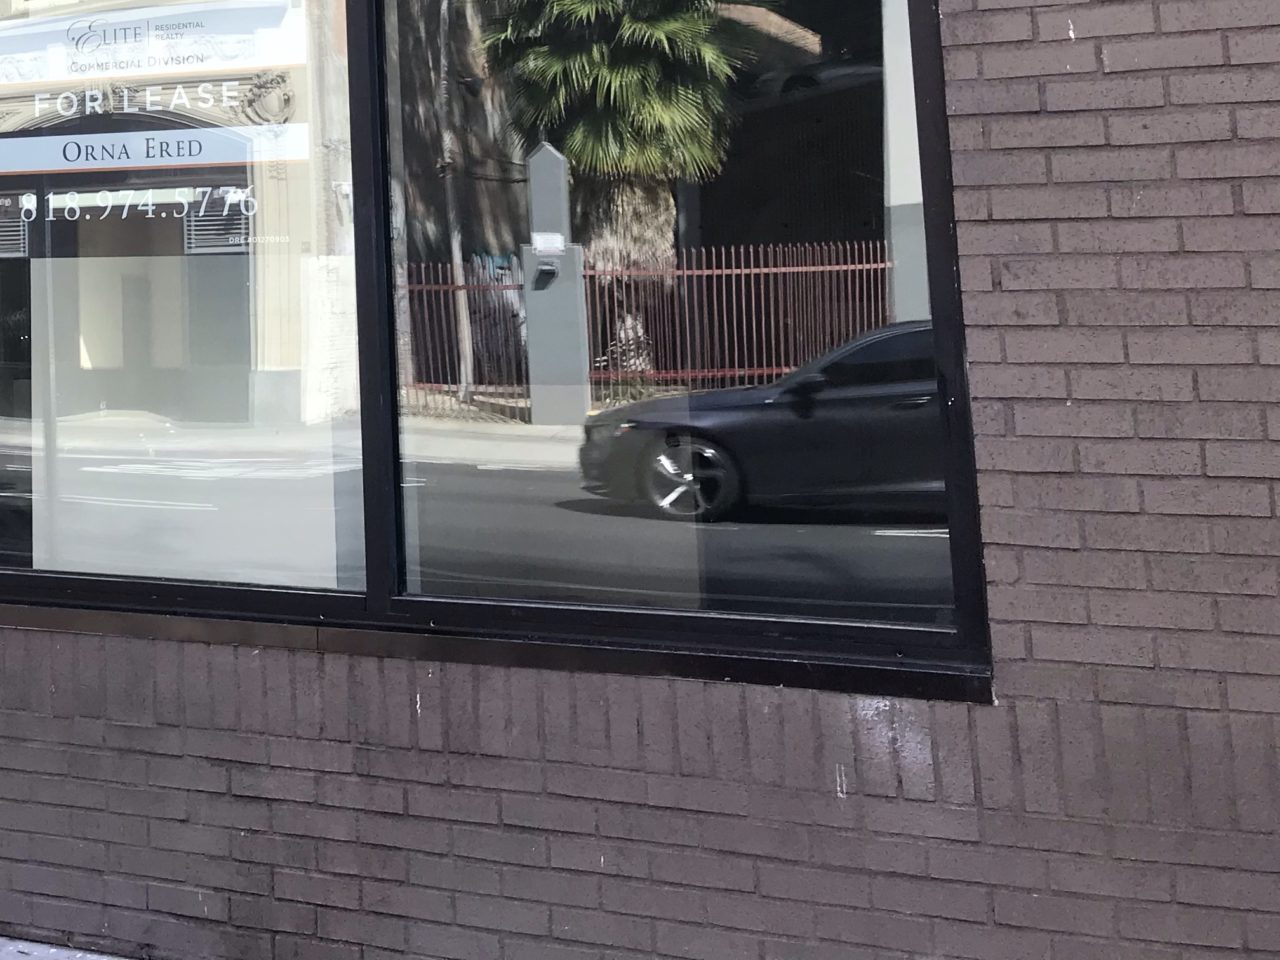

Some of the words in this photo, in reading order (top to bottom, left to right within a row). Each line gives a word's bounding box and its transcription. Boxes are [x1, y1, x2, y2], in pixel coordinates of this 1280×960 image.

[67, 19, 142, 54] ELITE
[154, 21, 206, 31] RESIDENTIAL
[154, 32, 184, 41] REALTY
[70, 59, 142, 73] COMMERCIAL
[147, 54, 205, 68] DIVISION
[34, 90, 103, 117] FOR
[123, 81, 240, 112] LEASE
[62, 140, 131, 162] ORNA
[144, 137, 203, 159] ERED
[20, 185, 258, 222] 818.974.5776
